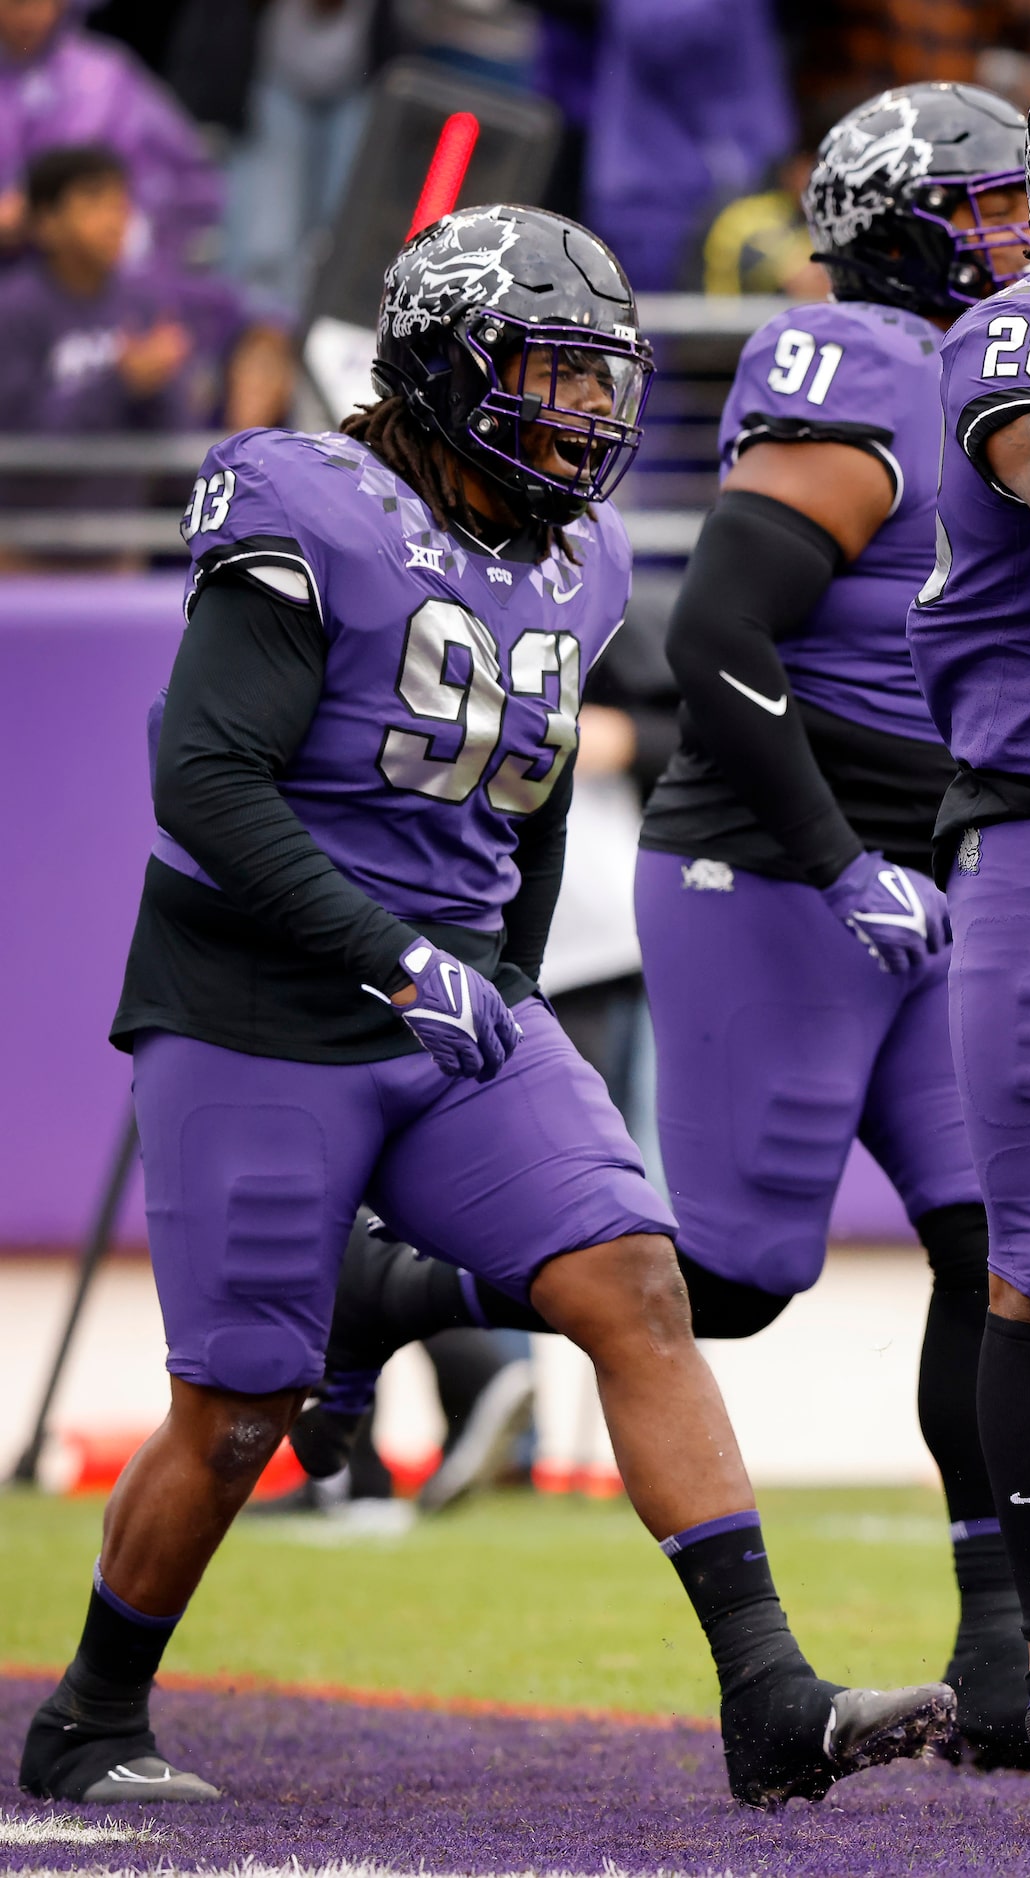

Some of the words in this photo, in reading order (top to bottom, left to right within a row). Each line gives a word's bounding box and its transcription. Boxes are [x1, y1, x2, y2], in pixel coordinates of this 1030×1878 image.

[767, 328, 844, 406] 91
[405, 540, 445, 576] XII
[486, 566, 513, 586] TCU
[374, 595, 582, 817] 93
